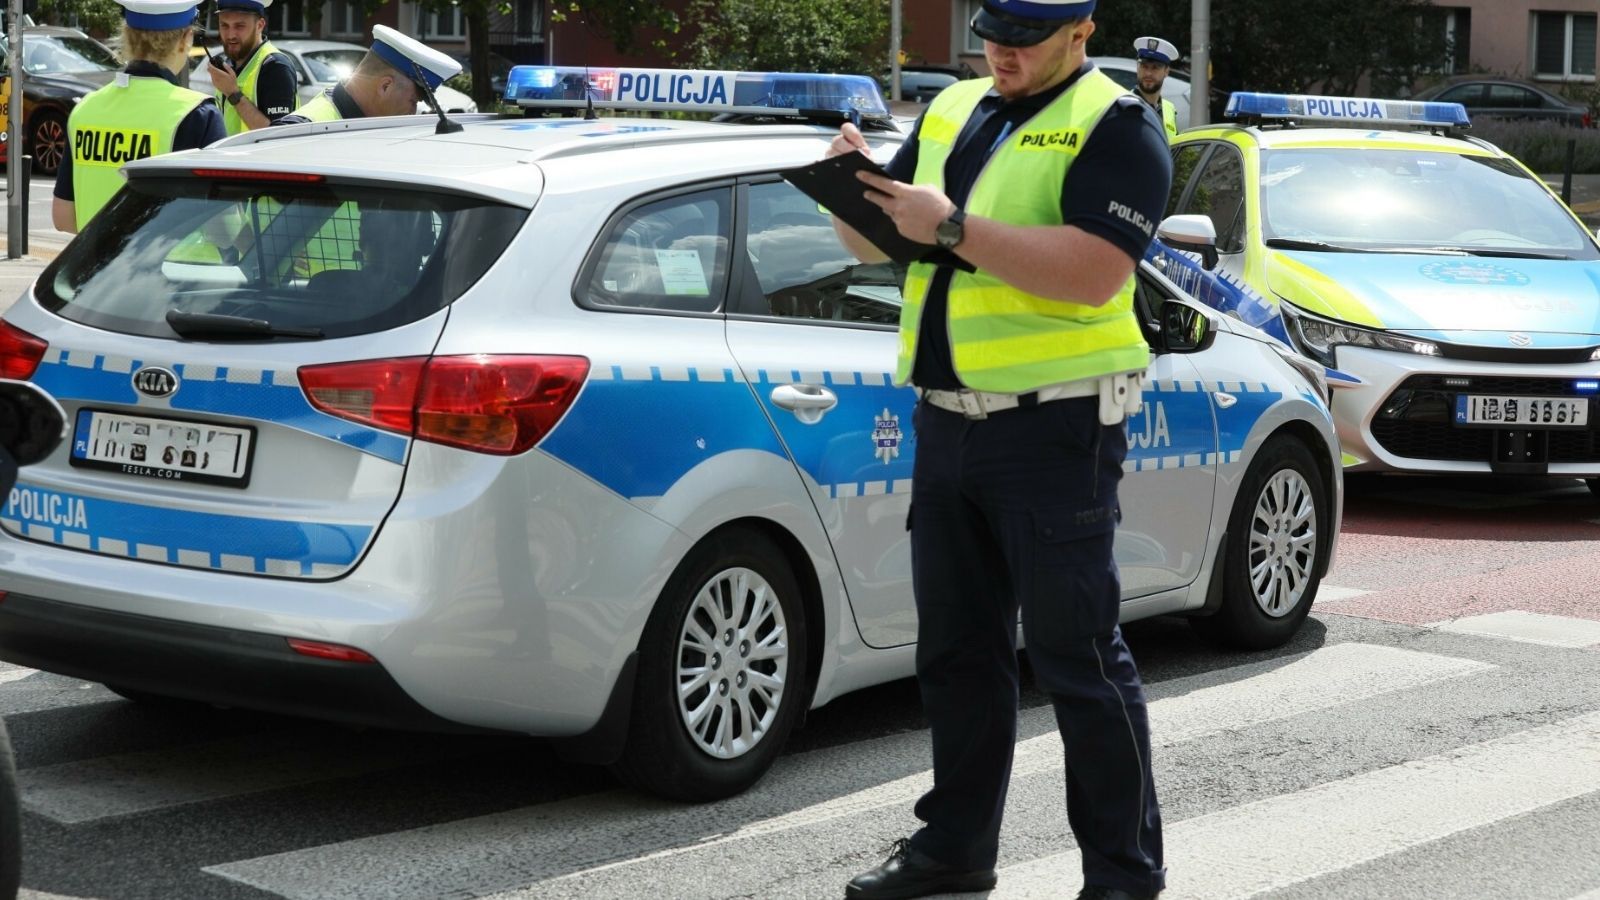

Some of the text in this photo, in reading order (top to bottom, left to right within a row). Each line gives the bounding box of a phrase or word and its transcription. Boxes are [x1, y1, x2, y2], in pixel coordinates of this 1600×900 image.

[617, 72, 727, 105] POLICJA
[1306, 98, 1383, 119] POLICJA
[75, 130, 151, 163] POLICJA
[1020, 132, 1078, 148] POLICJA
[1108, 200, 1153, 237] POLICJA
[139, 372, 169, 391] KIA
[877, 420, 897, 428] POLICJA
[76, 440, 86, 451] PL
[122, 464, 182, 479] TESLA.COM
[9, 488, 88, 529] POLICJA
